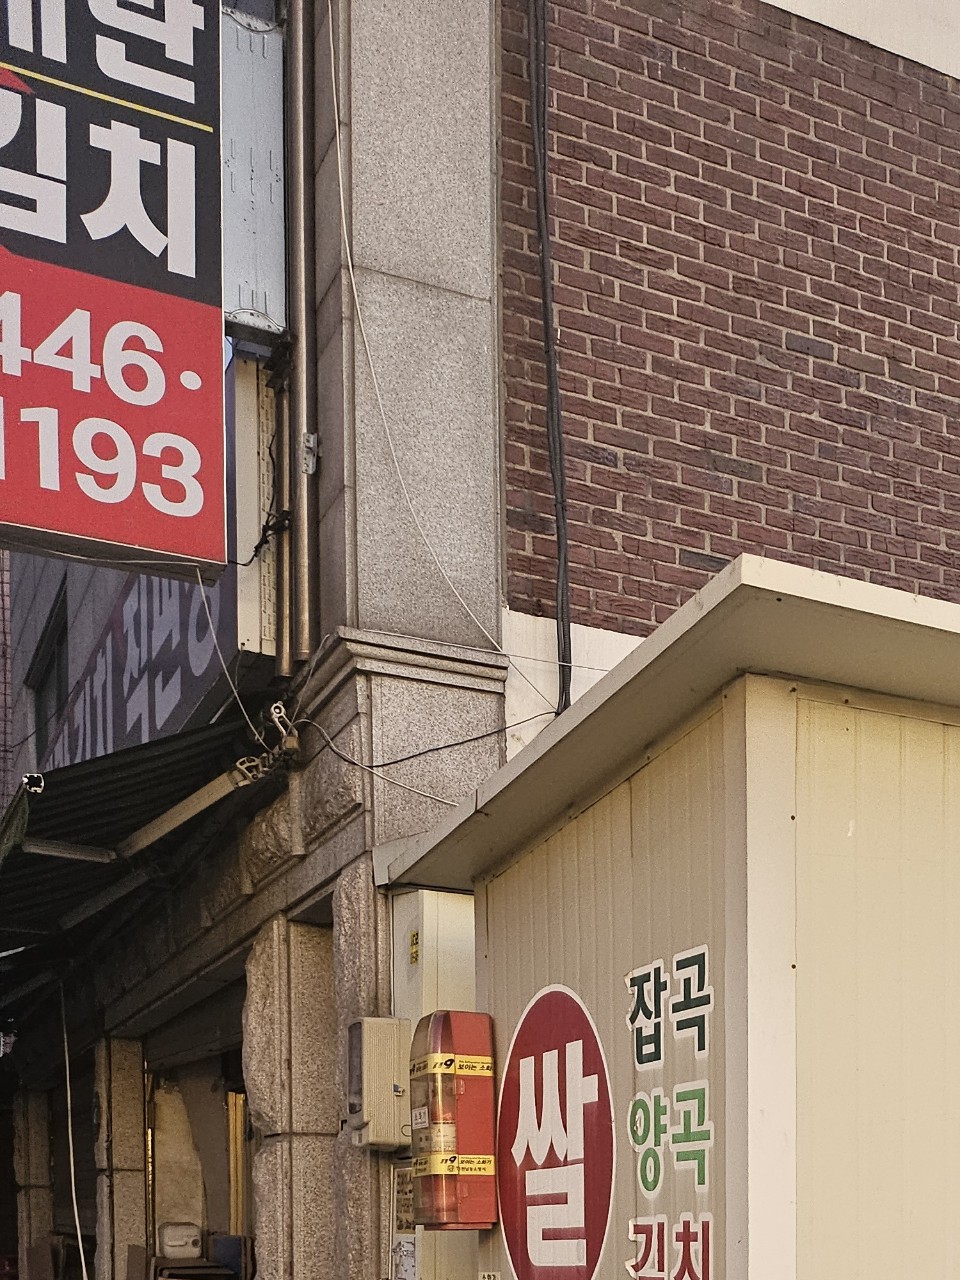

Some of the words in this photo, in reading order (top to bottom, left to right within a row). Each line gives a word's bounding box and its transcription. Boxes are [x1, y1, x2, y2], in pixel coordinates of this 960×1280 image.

[0, 396, 205, 518] 193
[629, 952, 711, 1065] 잡곡
[511, 1040, 599, 1267] 쌀
[629, 1087, 711, 1192] 양곡
